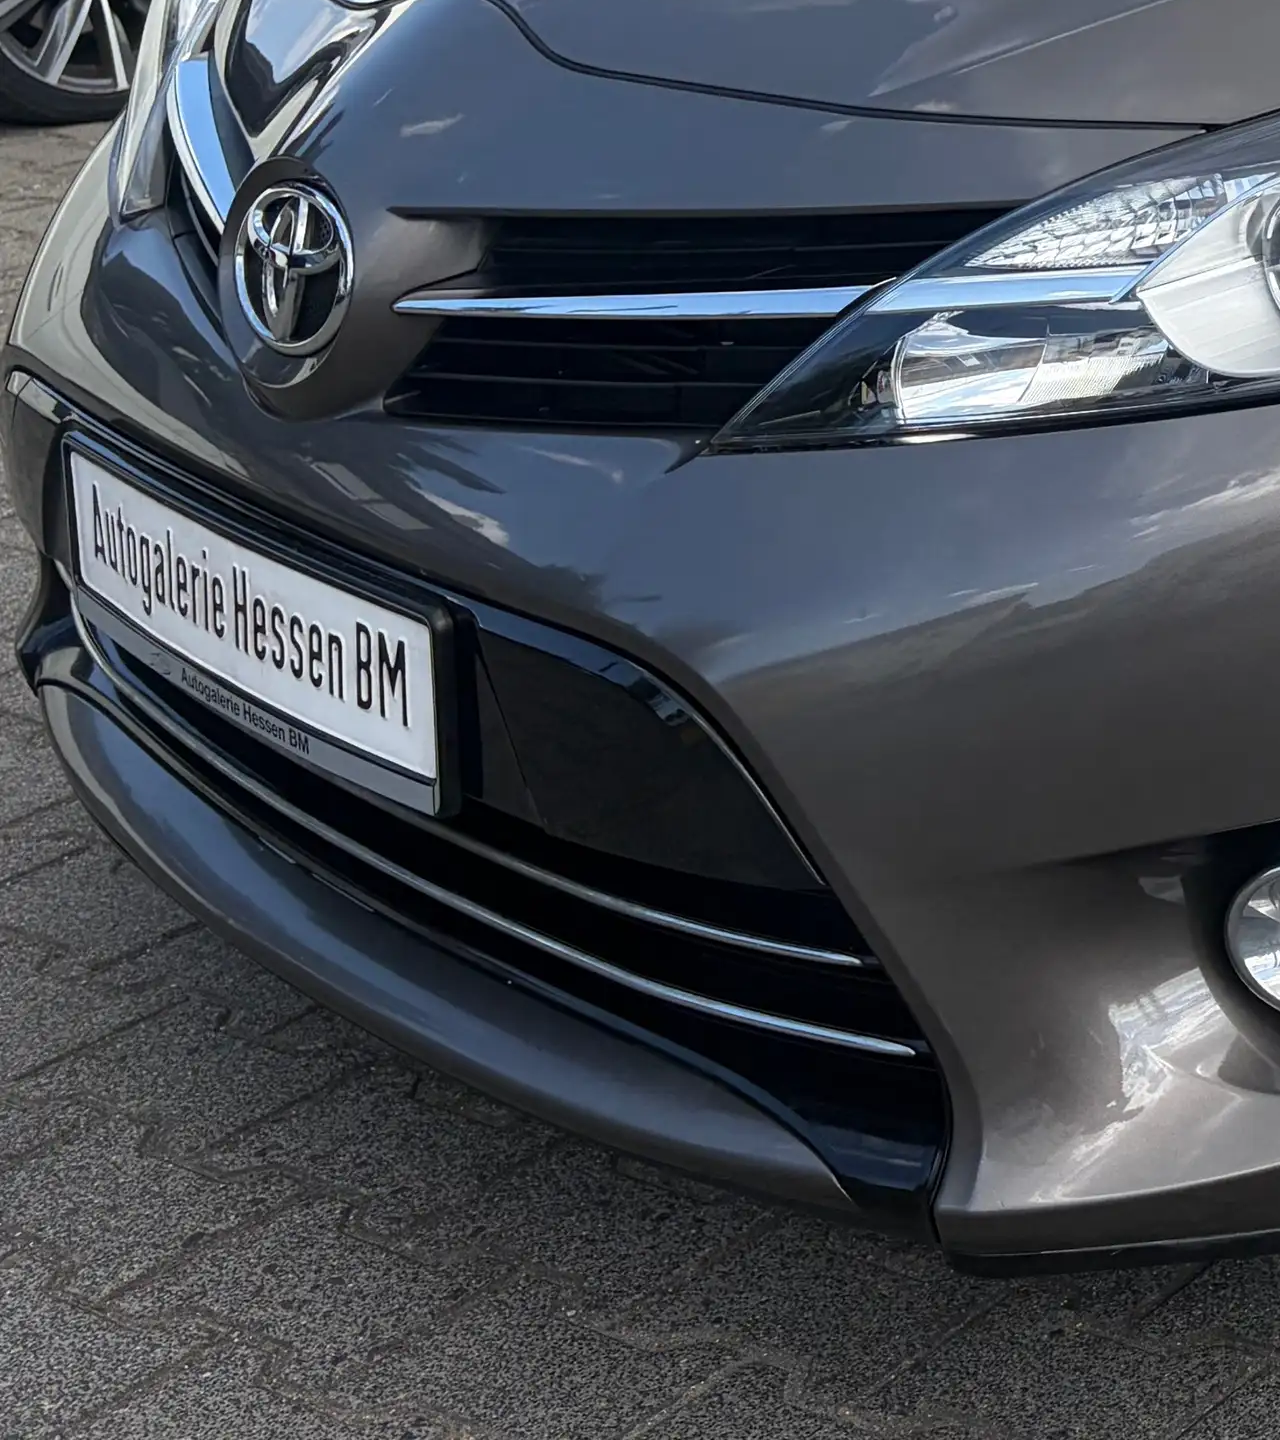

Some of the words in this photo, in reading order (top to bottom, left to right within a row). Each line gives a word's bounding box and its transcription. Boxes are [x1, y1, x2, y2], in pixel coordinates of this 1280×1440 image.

[91, 482, 226, 640] Autogalerie
[232, 564, 346, 701] Hessen
[355, 620, 410, 728] BM
[180, 666, 241, 716] Autogalerie
[242, 702, 287, 743] Hessen
[288, 727, 311, 755] BM
